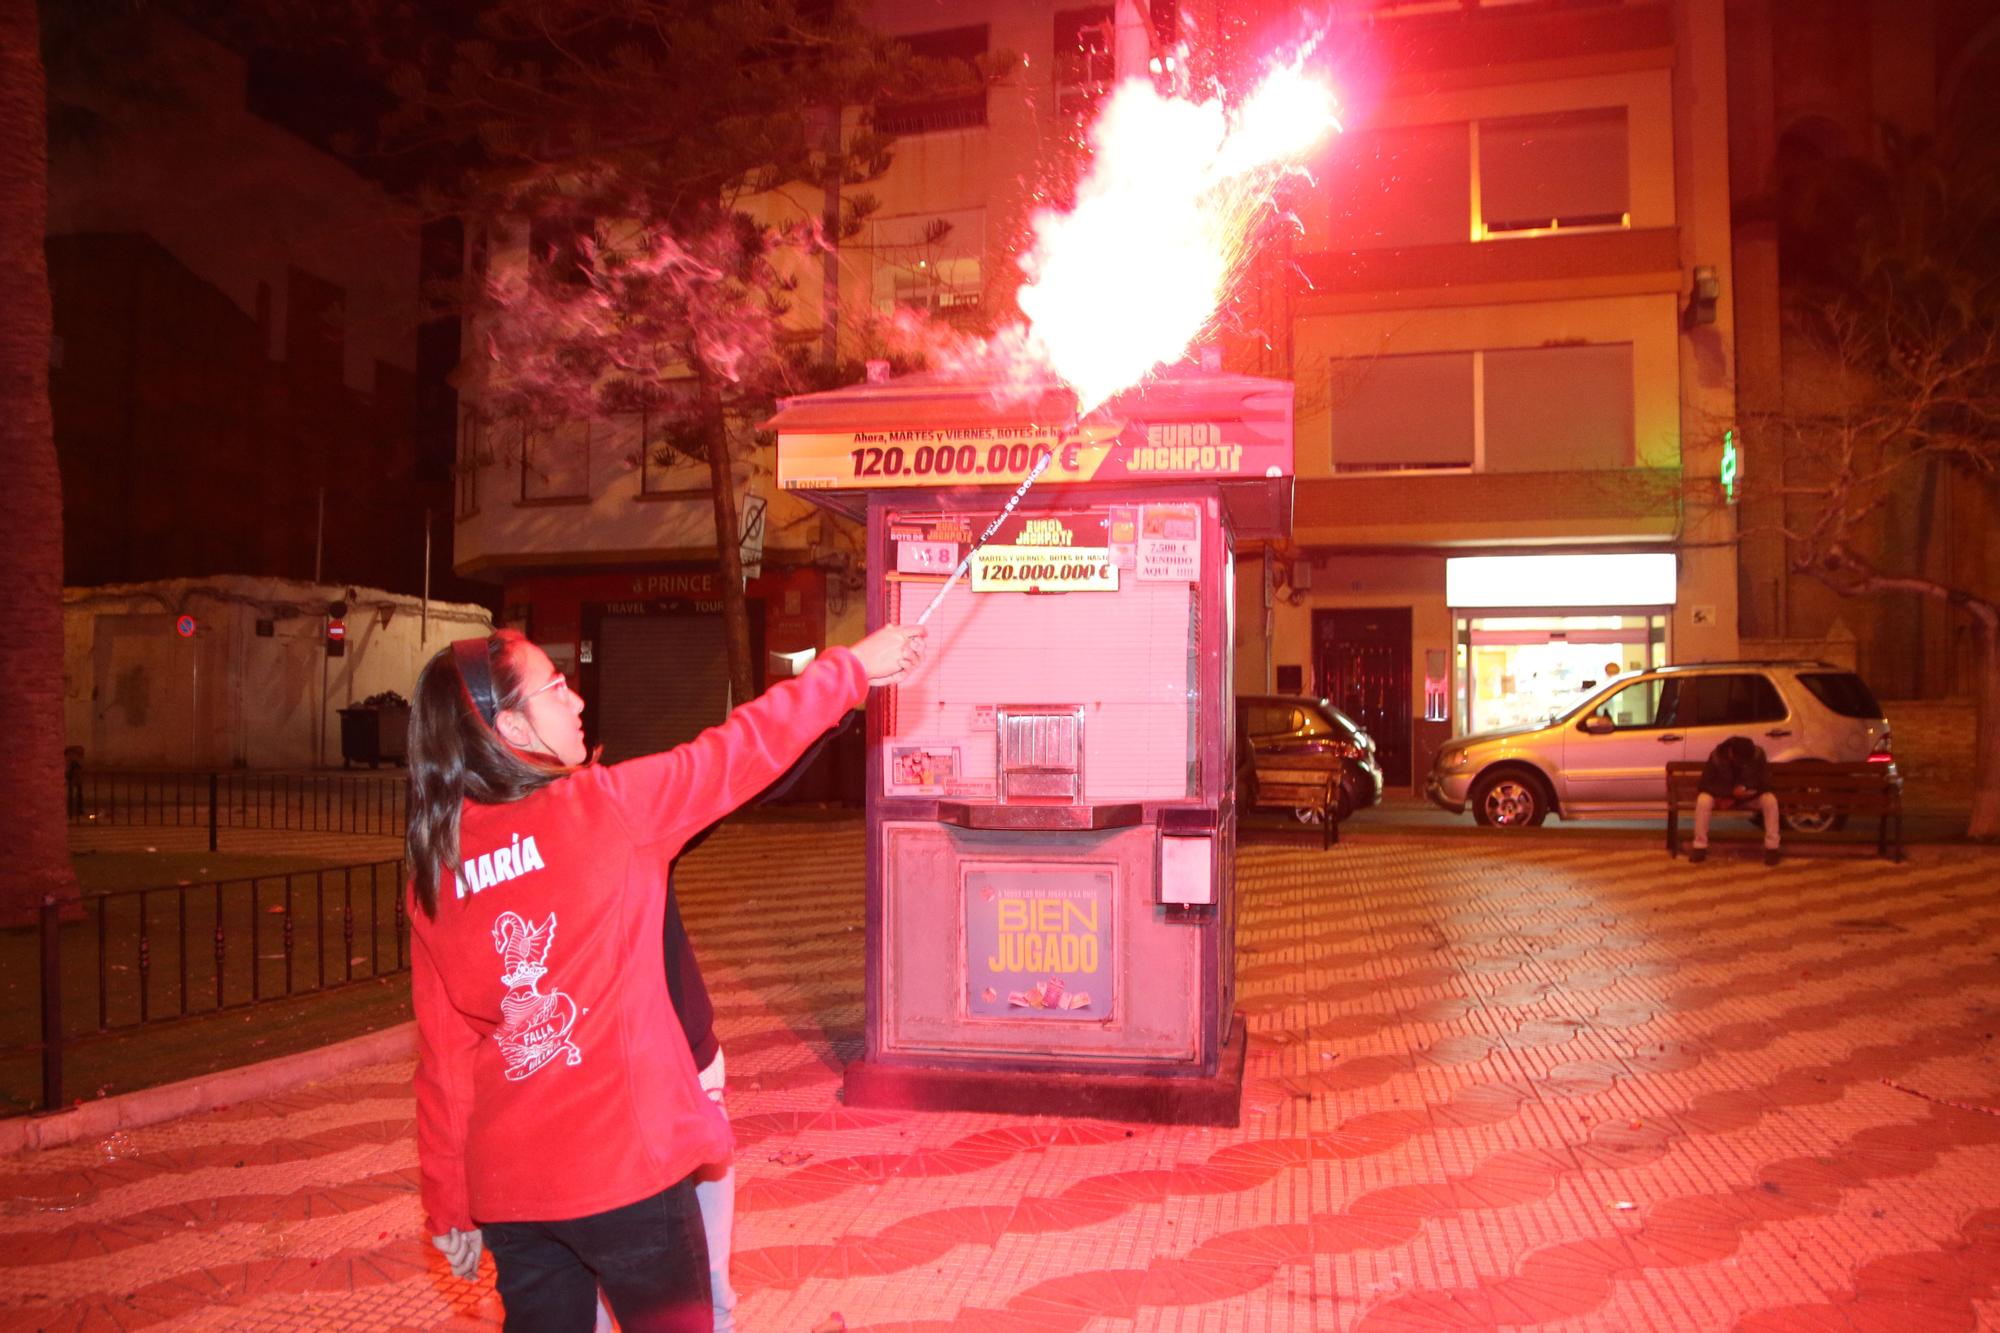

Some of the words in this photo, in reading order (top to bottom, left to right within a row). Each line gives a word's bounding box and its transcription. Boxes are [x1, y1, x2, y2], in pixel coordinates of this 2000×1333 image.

[854, 432, 888, 444] Ahora,
[889, 430, 934, 441] MARTES
[937, 433, 943, 441] y
[946, 428, 994, 440] VIERNES,
[998, 428, 1033, 439] BOTES
[850, 444, 1052, 477] 120.000.000
[1061, 442, 1082, 472] €
[648, 575, 712, 593] PRINCE
[981, 564, 1096, 581] 120.000.000
[606, 600, 646, 615] TRAVEL
[455, 833, 545, 899] MARÍA
[998, 898, 1098, 932] BIEN
[988, 932, 1098, 973] JUGADO
[523, 1023, 555, 1047] FALLA
